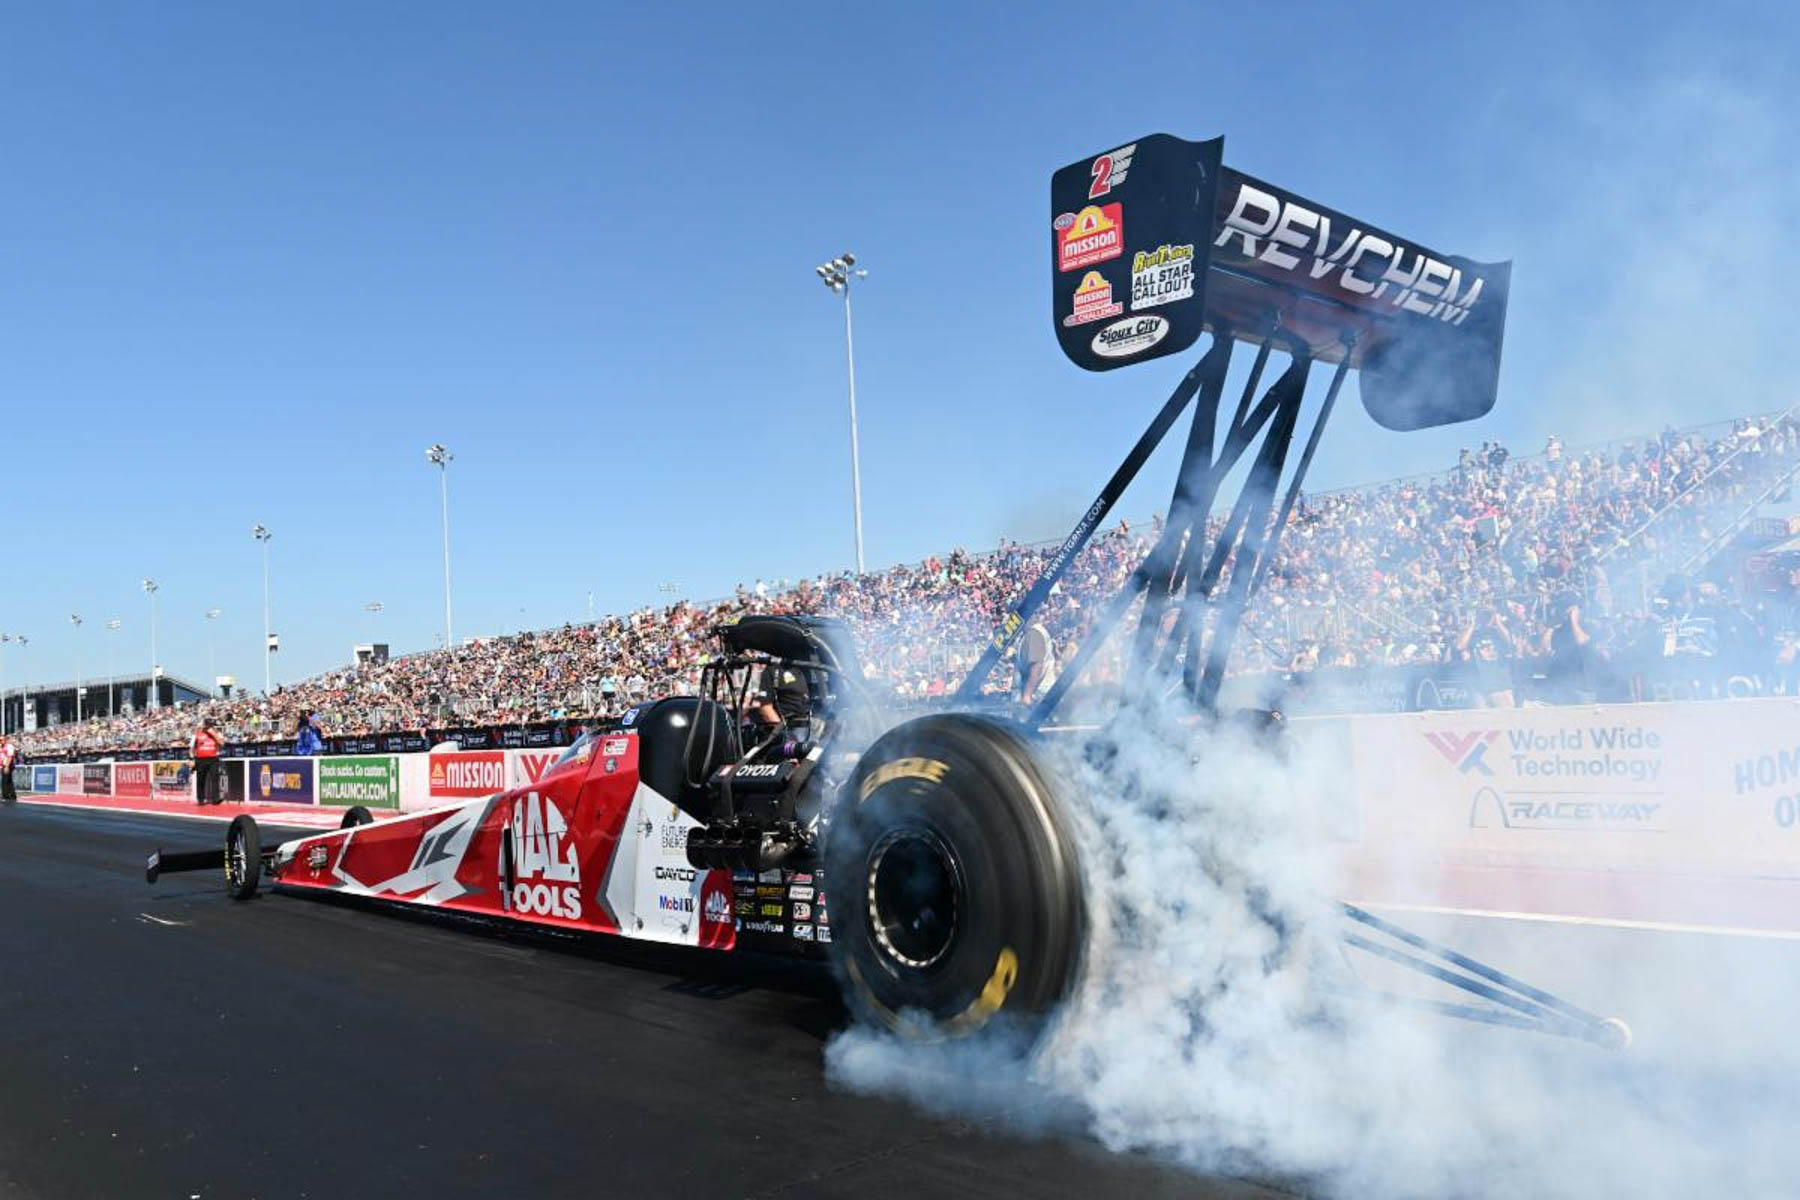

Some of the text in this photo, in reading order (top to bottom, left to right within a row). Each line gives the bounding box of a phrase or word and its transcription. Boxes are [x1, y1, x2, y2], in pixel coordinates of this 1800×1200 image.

[1089, 154, 1113, 199] 2
[1214, 184, 1484, 327] REVCHEM
[1133, 276, 1190, 301] CALLOUT
[1134, 263, 1190, 289] ALL STAR
[1099, 327, 1133, 343] Sioux
[1136, 318, 1161, 336] City
[1508, 727, 1660, 752] World Wide
[736, 765, 779, 776] OYOTA
[1511, 754, 1662, 781] Technology
[1508, 802, 1661, 822] RACEWAY
[655, 866, 696, 882] DAYCO
[659, 895, 683, 911] Mobil
